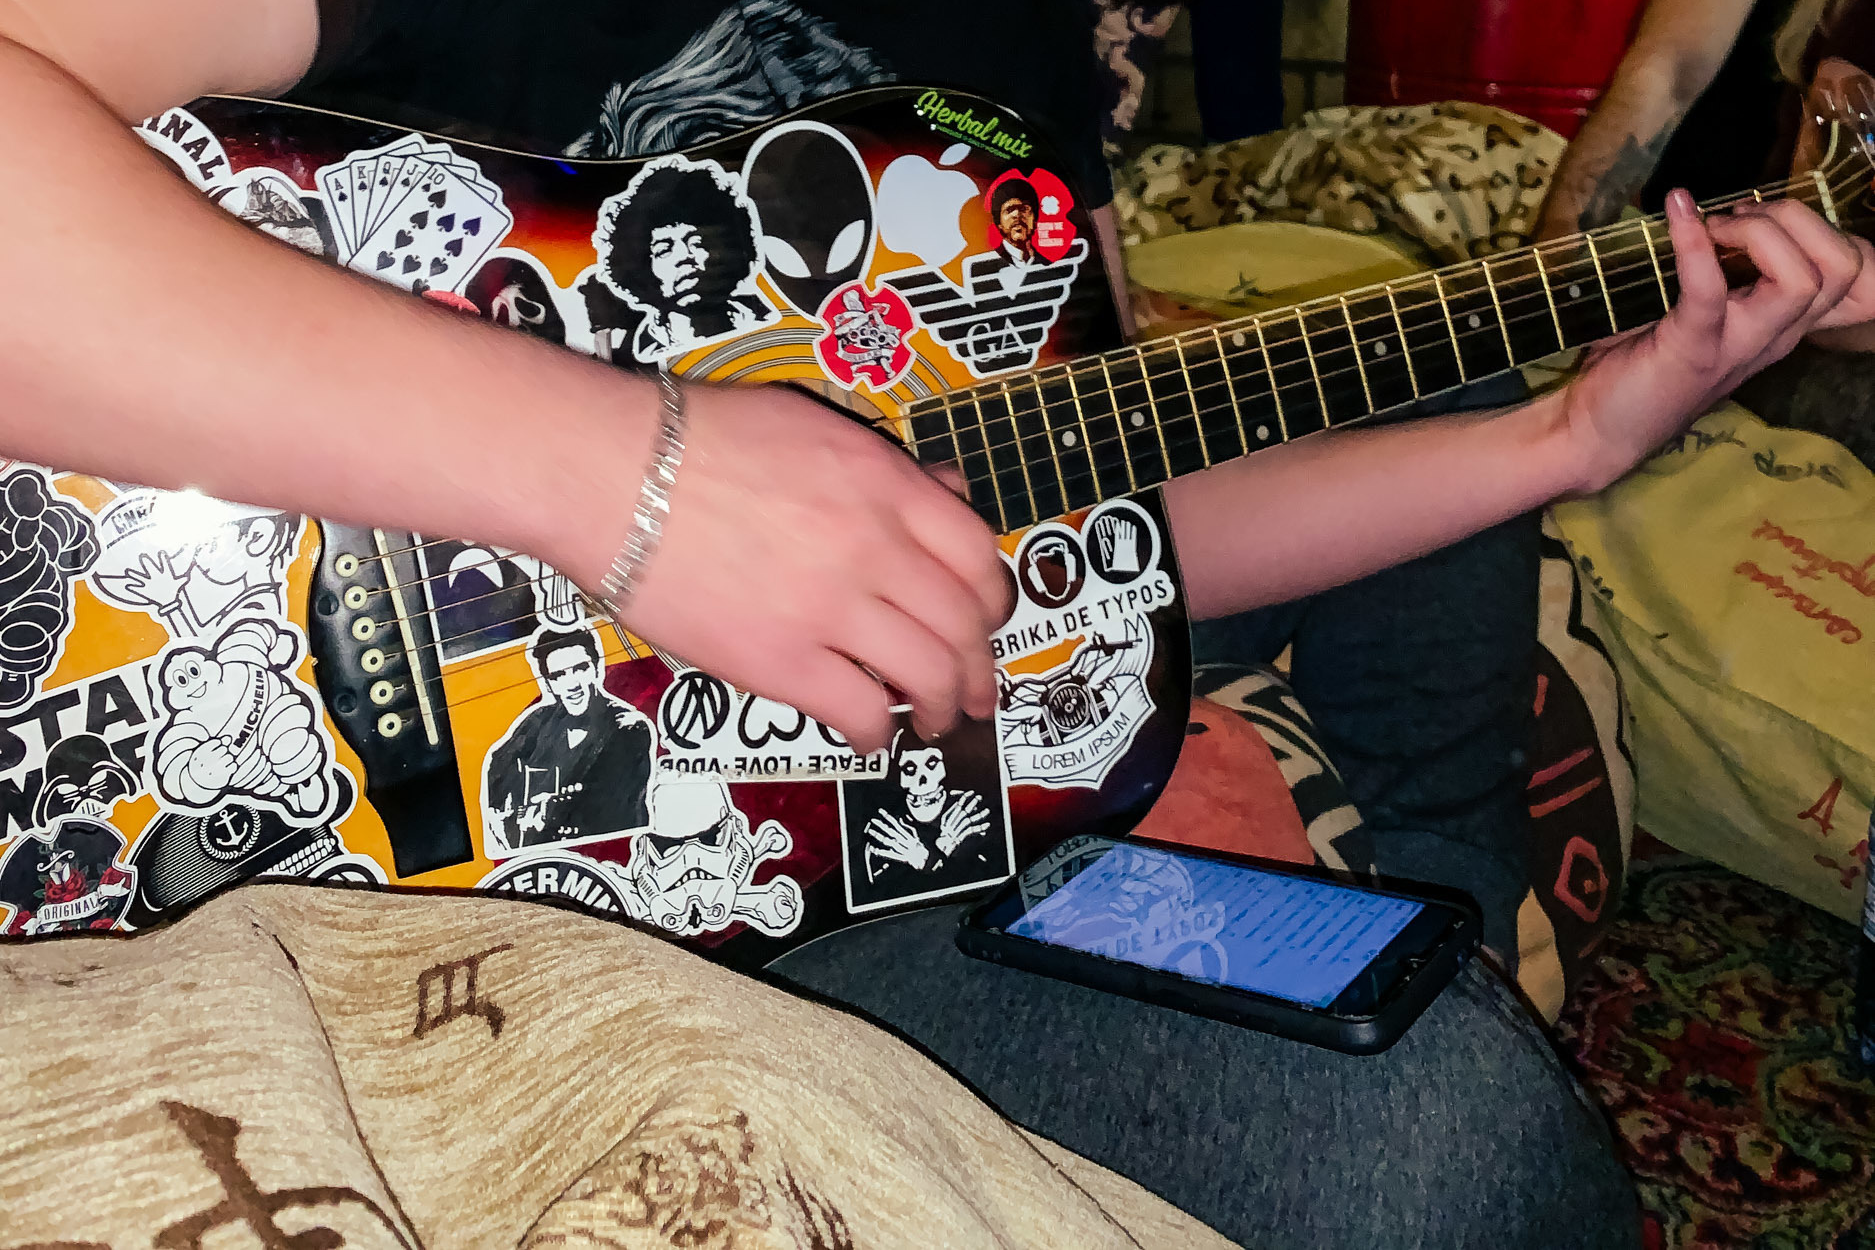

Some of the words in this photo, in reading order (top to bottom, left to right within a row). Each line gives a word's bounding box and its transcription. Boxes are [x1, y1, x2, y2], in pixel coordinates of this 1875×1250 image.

[917, 91, 999, 141] Herbal
[991, 131, 1033, 158] mix
[357, 166, 366, 179] K
[383, 161, 391, 174] Q
[407, 164, 418, 176] J
[427, 168, 446, 185] 10
[1063, 606, 1092, 632] DE
[1098, 580, 1167, 619] TYPOS
[233, 670, 264, 748] MICHELIN
[808, 753, 882, 773] PEACE
[1032, 748, 1086, 769] LOREM
[1088, 712, 1130, 756] IPSUM
[734, 755, 792, 775] LOVE
[44, 896, 99, 921] ORIGINAL
[498, 867, 620, 912] ERMI
